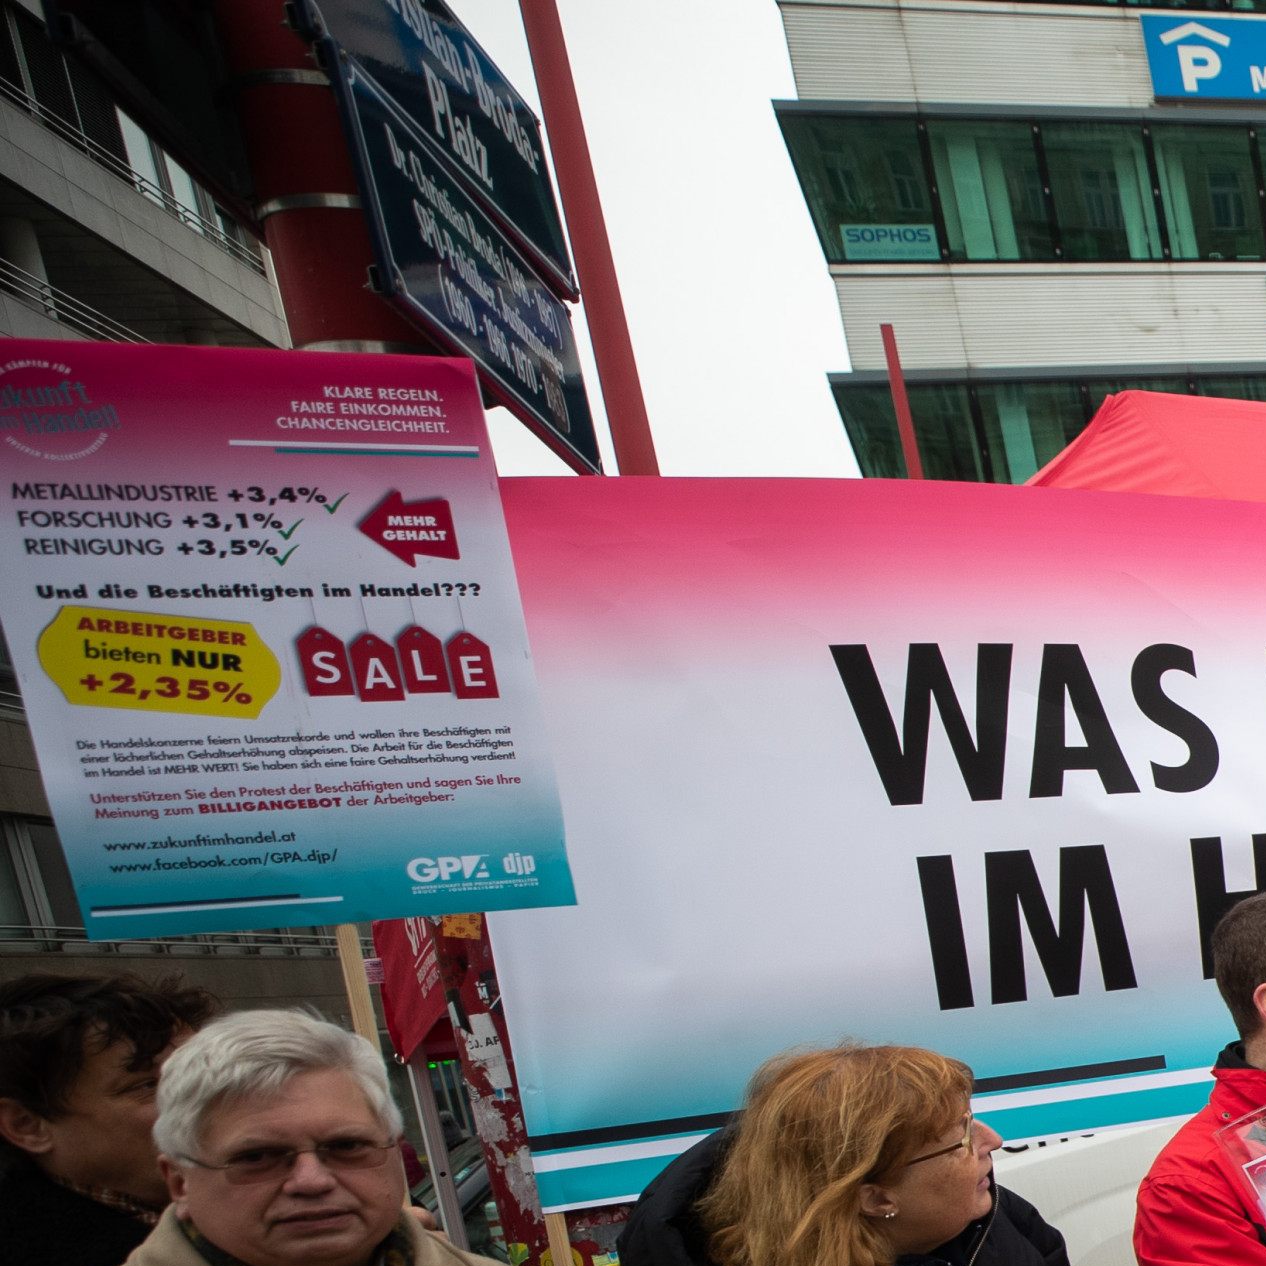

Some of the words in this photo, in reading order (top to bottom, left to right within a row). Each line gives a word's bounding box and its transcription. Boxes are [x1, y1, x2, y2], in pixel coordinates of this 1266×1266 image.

[422, 60, 493, 191] Platz
[410, 151, 471, 243] Christian
[465, 210, 507, 281] Broda
[845, 228, 931, 243] SOPHOS
[323, 386, 373, 399] KLARE
[378, 388, 443, 402] REGELN.
[291, 401, 335, 414] FAIRE
[340, 403, 447, 418] EINKOMMEN.
[276, 417, 450, 433] CHANCENGLEICHHEIT.
[12, 483, 219, 502] METALLINDUSTRIE
[227, 486, 328, 505] +3,4%
[17, 510, 172, 528] FORSCHUNG
[182, 513, 283, 531] +3,1%
[388, 516, 437, 527] MEHR
[383, 530, 447, 541] GEHALT
[24, 538, 165, 556] REINIGUNG
[177, 539, 278, 558] +3,5%
[36, 584, 88, 599] Und
[98, 584, 137, 598] die
[148, 584, 314, 601] Beschäftigten
[322, 583, 351, 597] im
[360, 583, 481, 597] Handel???
[77, 616, 247, 647] ARBEITGEBER
[84, 639, 161, 665] bieten
[171, 649, 243, 673] NUR
[80, 671, 253, 705] +2,35%
[828, 643, 1220, 806] WAS
[76, 740, 96, 750] Die
[100, 736, 204, 749] Handelskonzerne
[207, 735, 241, 746] feiern
[244, 731, 330, 744] Umsatzrekorde
[334, 731, 355, 741] und
[359, 730, 396, 740] wollen
[398, 728, 420, 738] ihre
[423, 726, 492, 739] Beschäftigten
[495, 726, 511, 735] mit
[80, 754, 109, 764] einer
[113, 750, 185, 763] lächerlichen
[188, 747, 286, 760] Gehaltserhöhung
[288, 745, 348, 758] abspeisen.
[351, 743, 370, 753] Die
[373, 742, 405, 752] Arbeit
[408, 741, 424, 751] für
[426, 740, 443, 750] die
[445, 738, 514, 751] Beschäftigten
[84, 768, 99, 778] im
[102, 765, 146, 777] Handel
[149, 765, 161, 775] ist
[164, 764, 199, 774] MEHR
[202, 762, 239, 774] WERT!
[242, 762, 259, 772] Sie
[262, 760, 298, 771] haben
[301, 759, 322, 769] sich
[324, 758, 348, 768] eine
[350, 756, 376, 766] faire
[378, 753, 469, 766] Gehaltserhöhung
[471, 751, 516, 761] verdient!
[89, 790, 181, 805] Unterstützen
[184, 788, 206, 800] Sie
[209, 787, 236, 799] den
[238, 784, 285, 798] Protest
[288, 783, 311, 795] der
[315, 780, 403, 794] Beschäftigten
[406, 776, 431, 788] und
[434, 776, 472, 790] sagen
[475, 775, 494, 786] Sie
[496, 773, 521, 784] Ihre
[95, 806, 160, 819] Meinung
[163, 806, 194, 817] zum
[198, 797, 342, 815] BILLIGANGEBOT
[346, 796, 369, 807] der
[373, 791, 455, 807] Arbeitgeber:
[103, 831, 297, 851] www.zukunftimhandel.at
[109, 848, 337, 873] www.facebook.com/GPA.djp/
[502, 853, 536, 875] djp
[916, 844, 1138, 1011] IM
